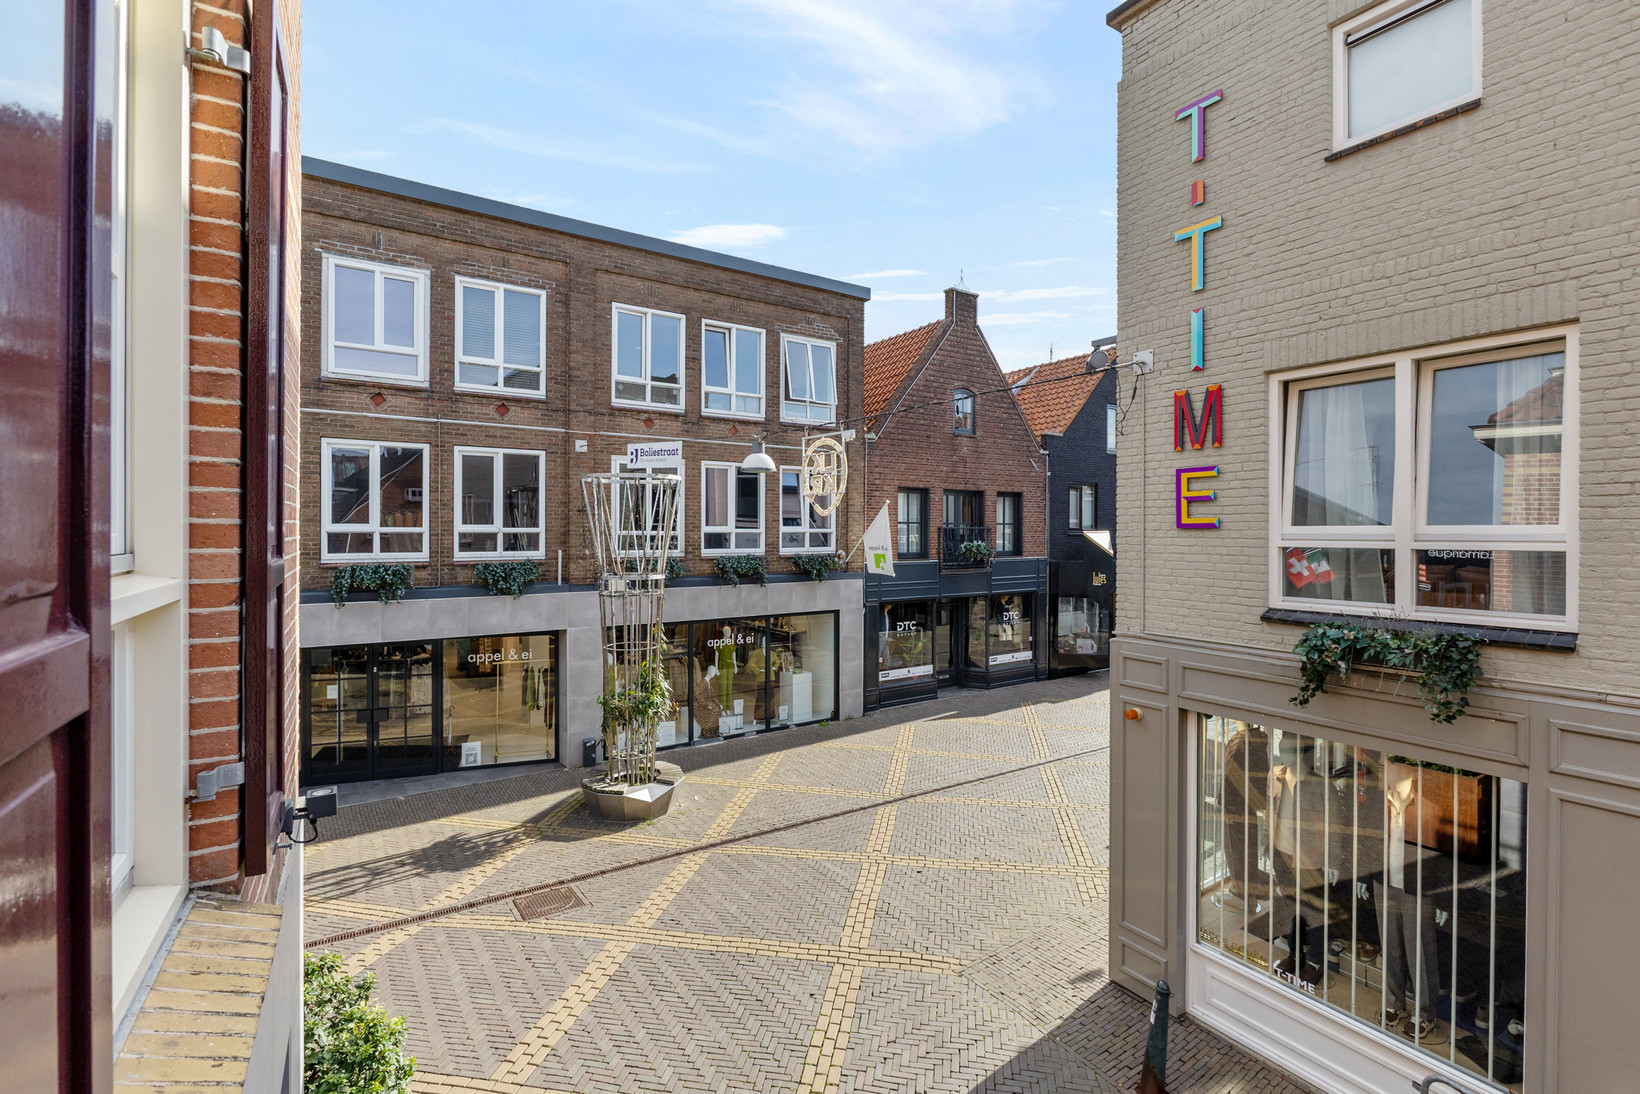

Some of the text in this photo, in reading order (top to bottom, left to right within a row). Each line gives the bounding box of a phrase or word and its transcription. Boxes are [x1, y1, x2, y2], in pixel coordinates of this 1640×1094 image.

[640, 447, 679, 457] Boliestraat
[1003, 612, 1019, 621] DTC
[896, 621, 917, 631] DTC
[707, 632, 754, 650] appel & ei
[467, 647, 533, 666] appel & ei
[1274, 967, 1316, 995] T-TIME
